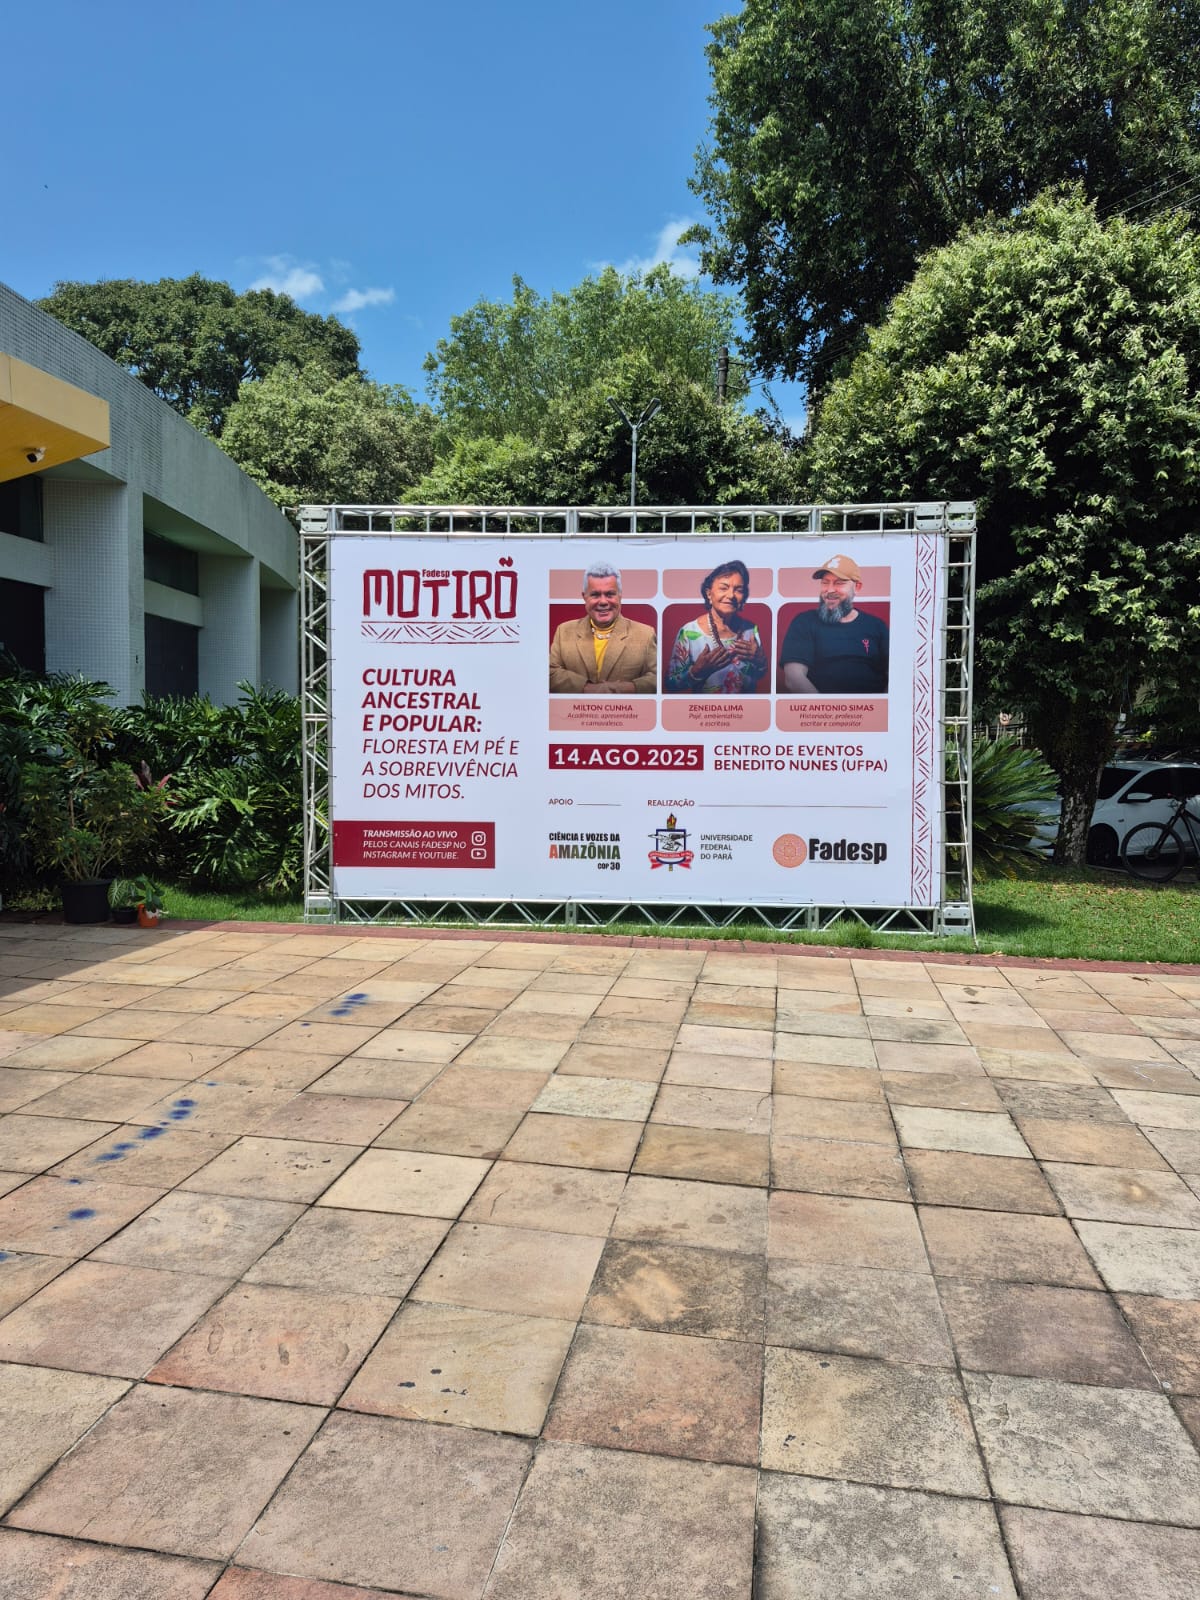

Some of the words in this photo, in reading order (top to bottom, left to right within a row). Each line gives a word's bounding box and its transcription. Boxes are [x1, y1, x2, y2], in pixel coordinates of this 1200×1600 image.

[422, 569, 450, 577] Fadesp
[363, 556, 518, 620] MOTIRÕ
[362, 668, 456, 686] CULTURA
[361, 692, 481, 710] ANCESTRAL
[362, 714, 375, 732] E
[379, 714, 482, 732] POPULAR:
[362, 738, 448, 754] FLORESTA
[453, 740, 479, 754] EM
[484, 736, 505, 755] PÉ
[510, 740, 520, 755] E
[714, 745, 771, 756] CENTRO
[776, 745, 794, 756] DE
[798, 745, 864, 756] EVENTOS
[554, 748, 698, 766] 14.AGO.2025
[362, 761, 374, 776] A
[378, 758, 518, 778] SOBREVIVÊNCIA
[714, 760, 786, 770] BENEDITO
[789, 760, 838, 771] NUNES
[842, 760, 888, 772] (UFPA)
[363, 783, 400, 798] DOS
[405, 784, 464, 799] MITOS.
[648, 798, 695, 807] REALIZAÇÃO
[363, 830, 422, 838] TRANSMISSÃO
[549, 832, 578, 841] CIÊNCIA
[580, 833, 585, 841] E
[586, 833, 608, 842] VOZES
[610, 834, 620, 842] DA
[549, 842, 621, 860] AMAZÔNIA
[712, 852, 732, 860] PARÁ
[809, 838, 887, 864] Fadesp
[610, 862, 620, 870] 30
